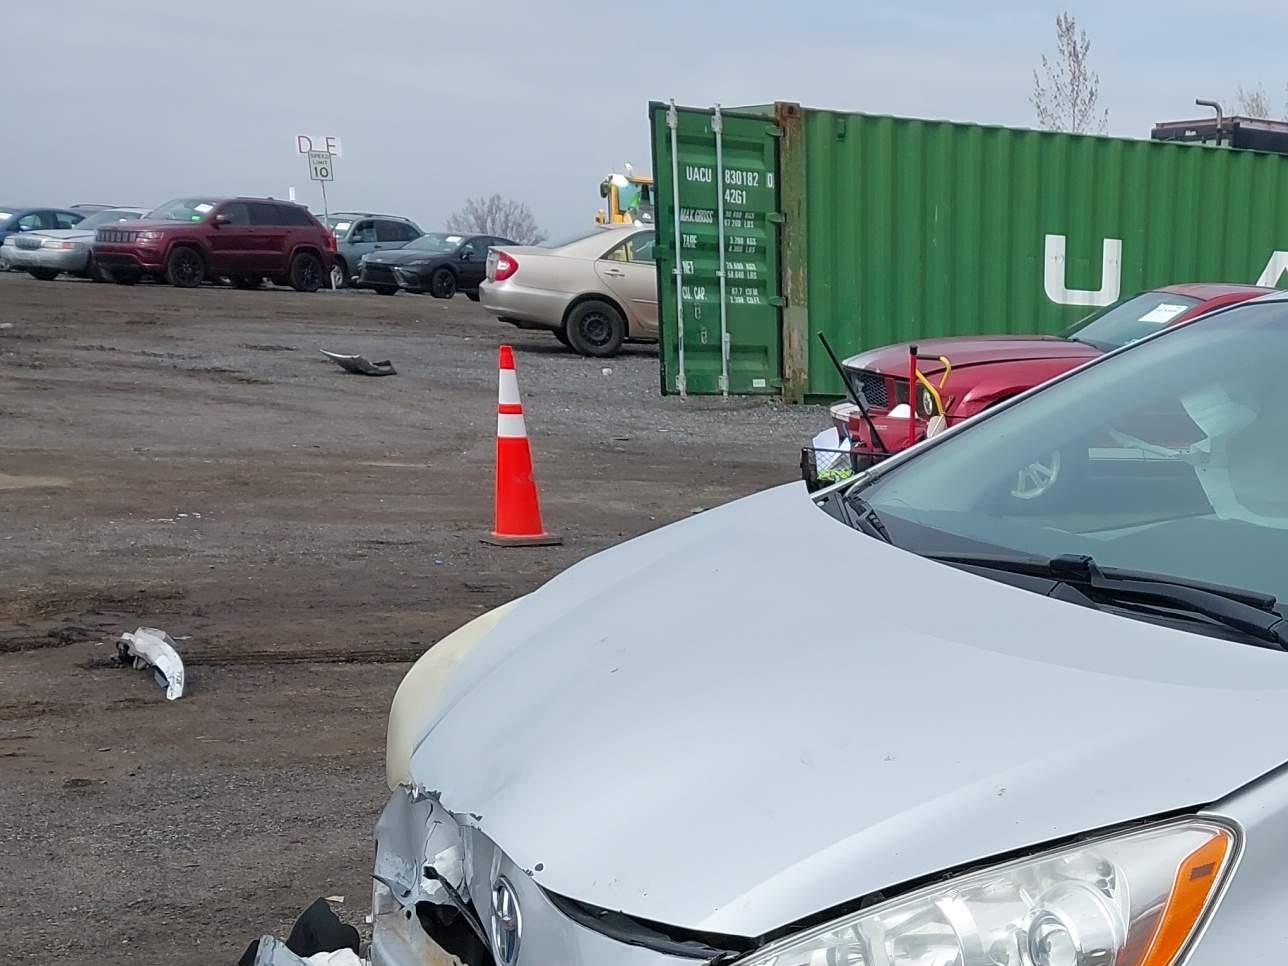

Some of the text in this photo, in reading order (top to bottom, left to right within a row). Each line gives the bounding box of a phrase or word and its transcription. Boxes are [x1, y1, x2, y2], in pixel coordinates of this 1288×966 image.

[298, 135, 313, 153] D
[314, 166, 329, 178] 10
[686, 166, 712, 182] UACU
[724, 169, 759, 187] 830182
[724, 189, 746, 205] 42G1
[682, 260, 695, 275] NET
